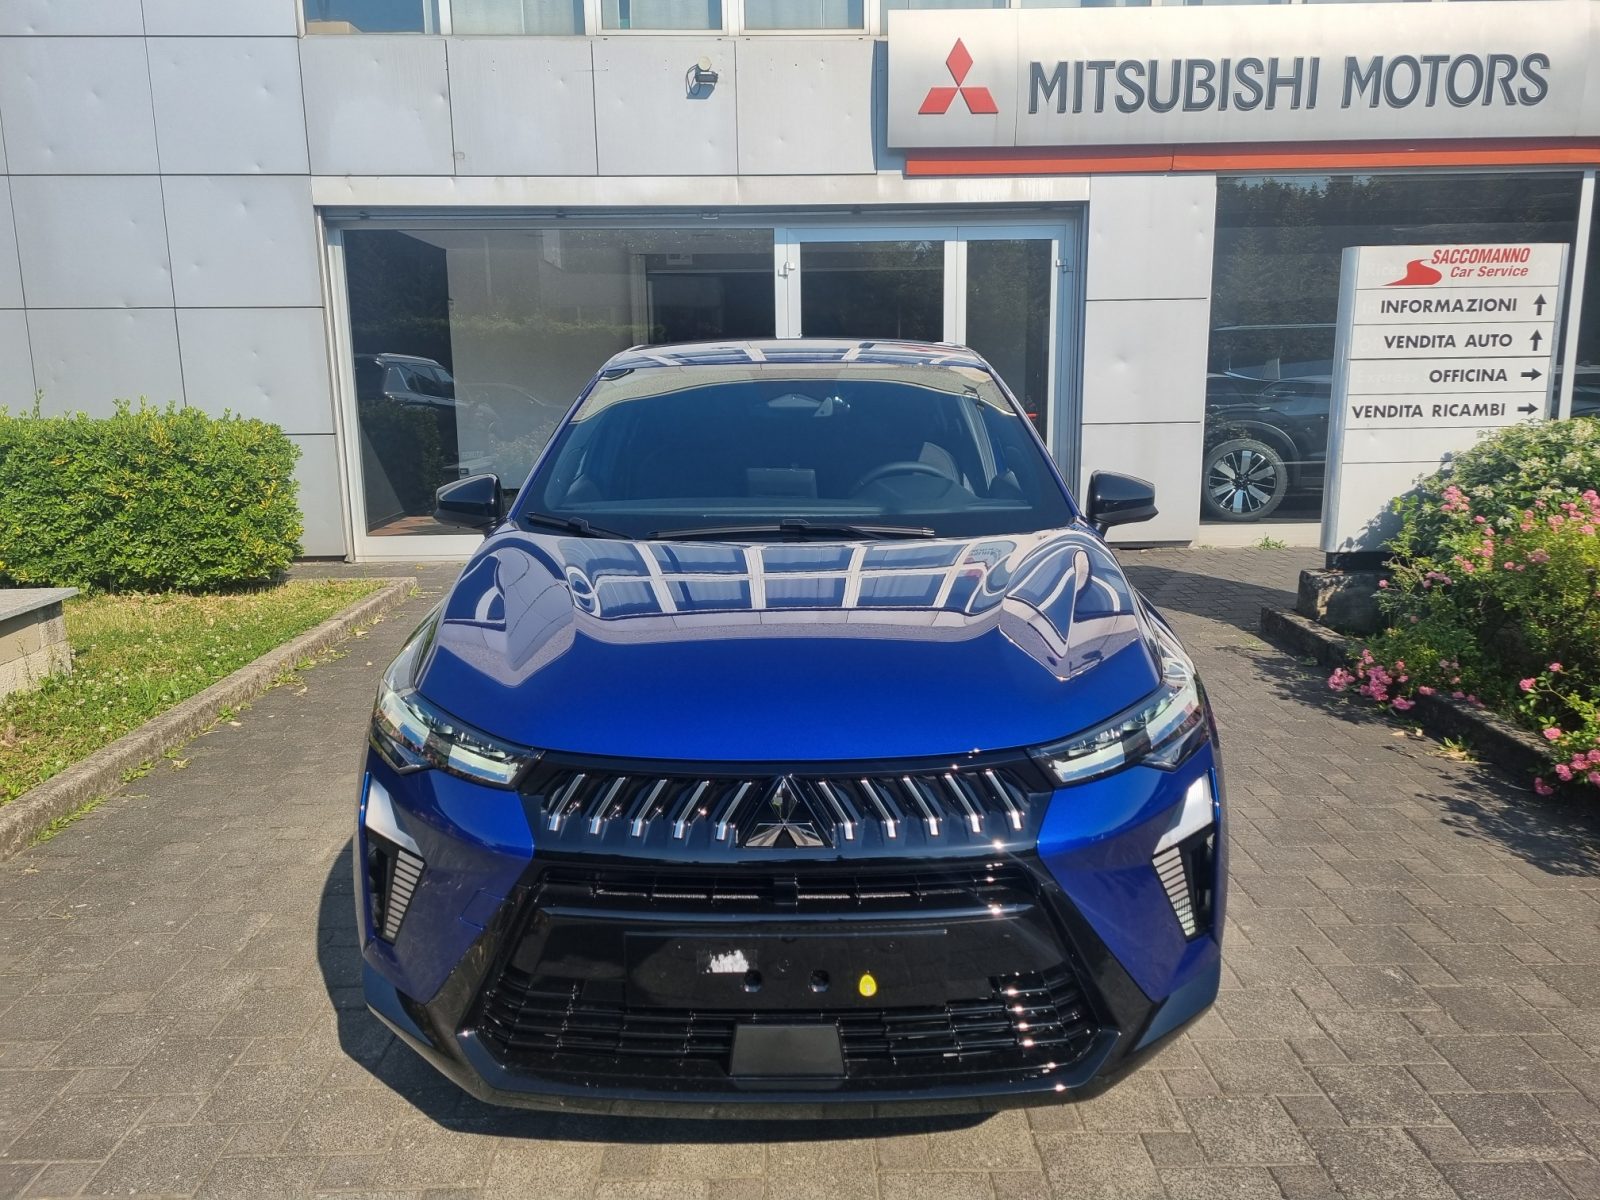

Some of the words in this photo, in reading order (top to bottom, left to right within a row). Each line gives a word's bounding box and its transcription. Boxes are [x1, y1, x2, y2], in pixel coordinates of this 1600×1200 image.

[1028, 57, 1320, 115] MITSUBISHI
[1341, 53, 1550, 109] MOTORS
[1430, 247, 1531, 264] SACCOMANNO
[1450, 265, 1473, 278] Car
[1477, 264, 1529, 277] Service
[1380, 298, 1518, 314] INFORMAZIONI
[1383, 335, 1457, 349] VENDITA
[1464, 333, 1513, 348] AUTO
[1428, 368, 1508, 383] OFFICINA
[1351, 404, 1424, 419] VENDITA
[1431, 402, 1506, 418] RICAMBI
